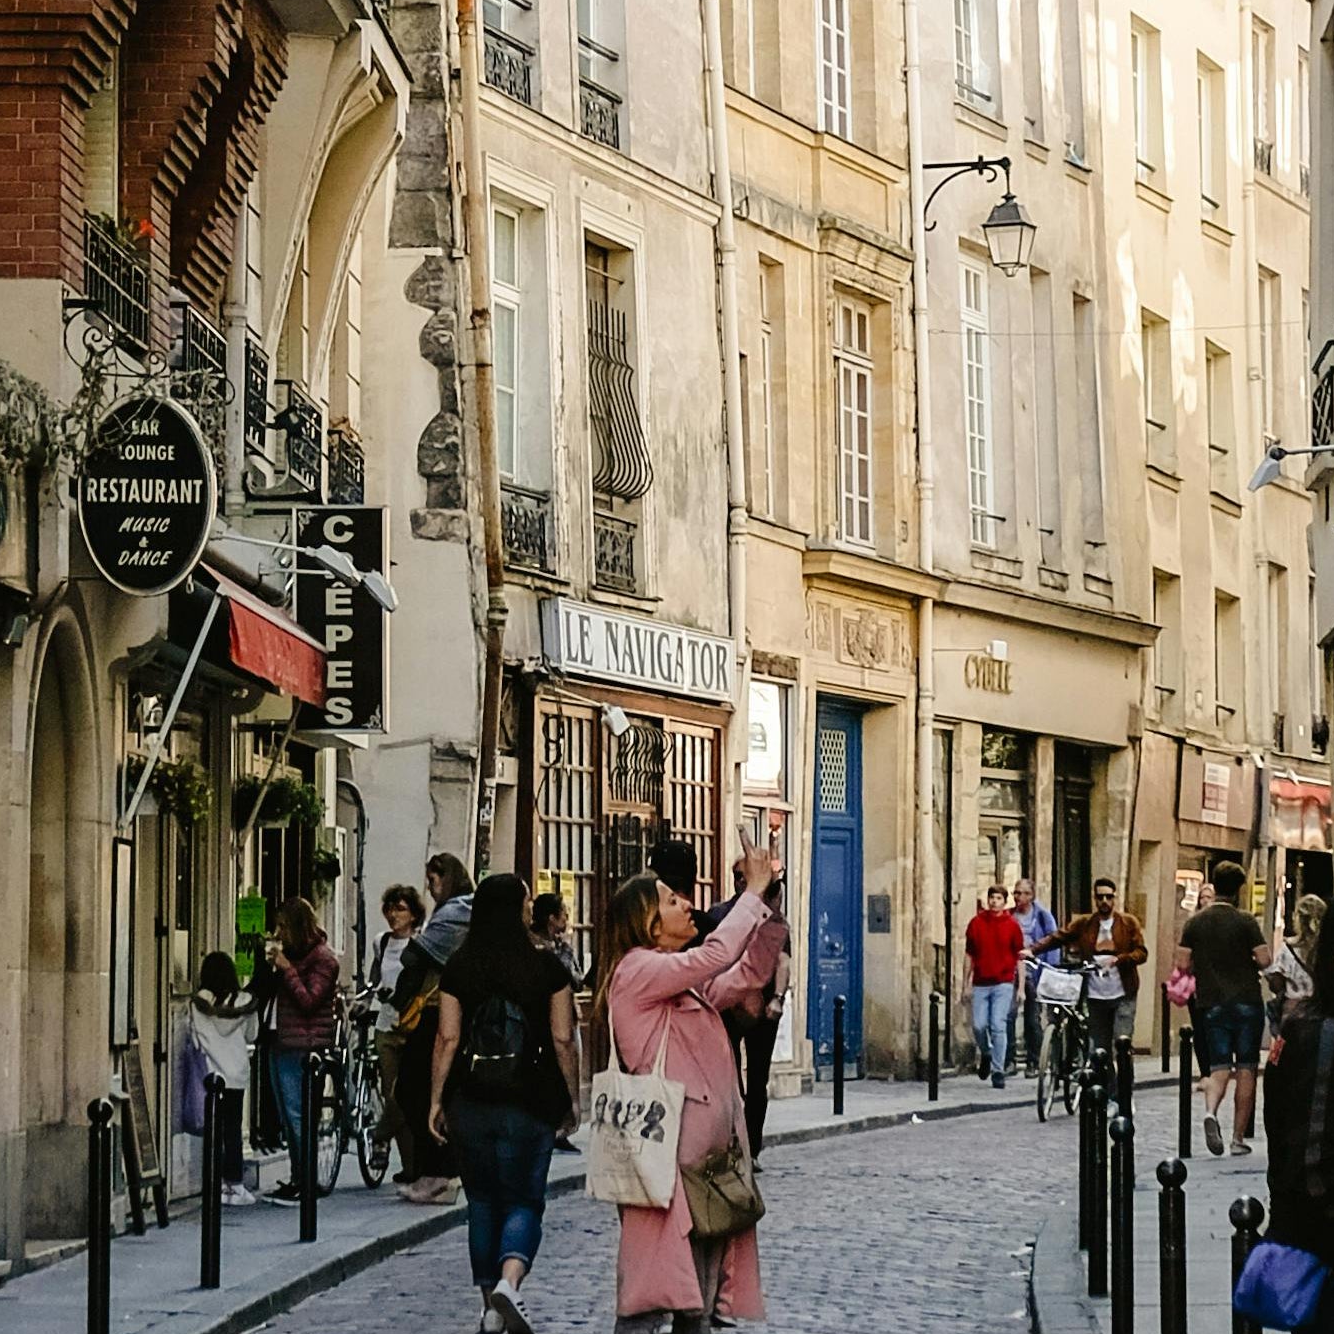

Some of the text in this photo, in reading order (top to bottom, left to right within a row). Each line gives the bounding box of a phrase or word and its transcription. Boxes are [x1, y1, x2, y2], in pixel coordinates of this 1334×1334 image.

[132, 419, 160, 436] BAR
[118, 444, 175, 461] LOUNGE
[87, 477, 203, 504] RESTAURANT
[119, 517, 170, 533] MUSIC
[138, 536, 149, 548] &
[118, 550, 173, 566] DANCE
[565, 611, 730, 692] LE NAVIGATOR
